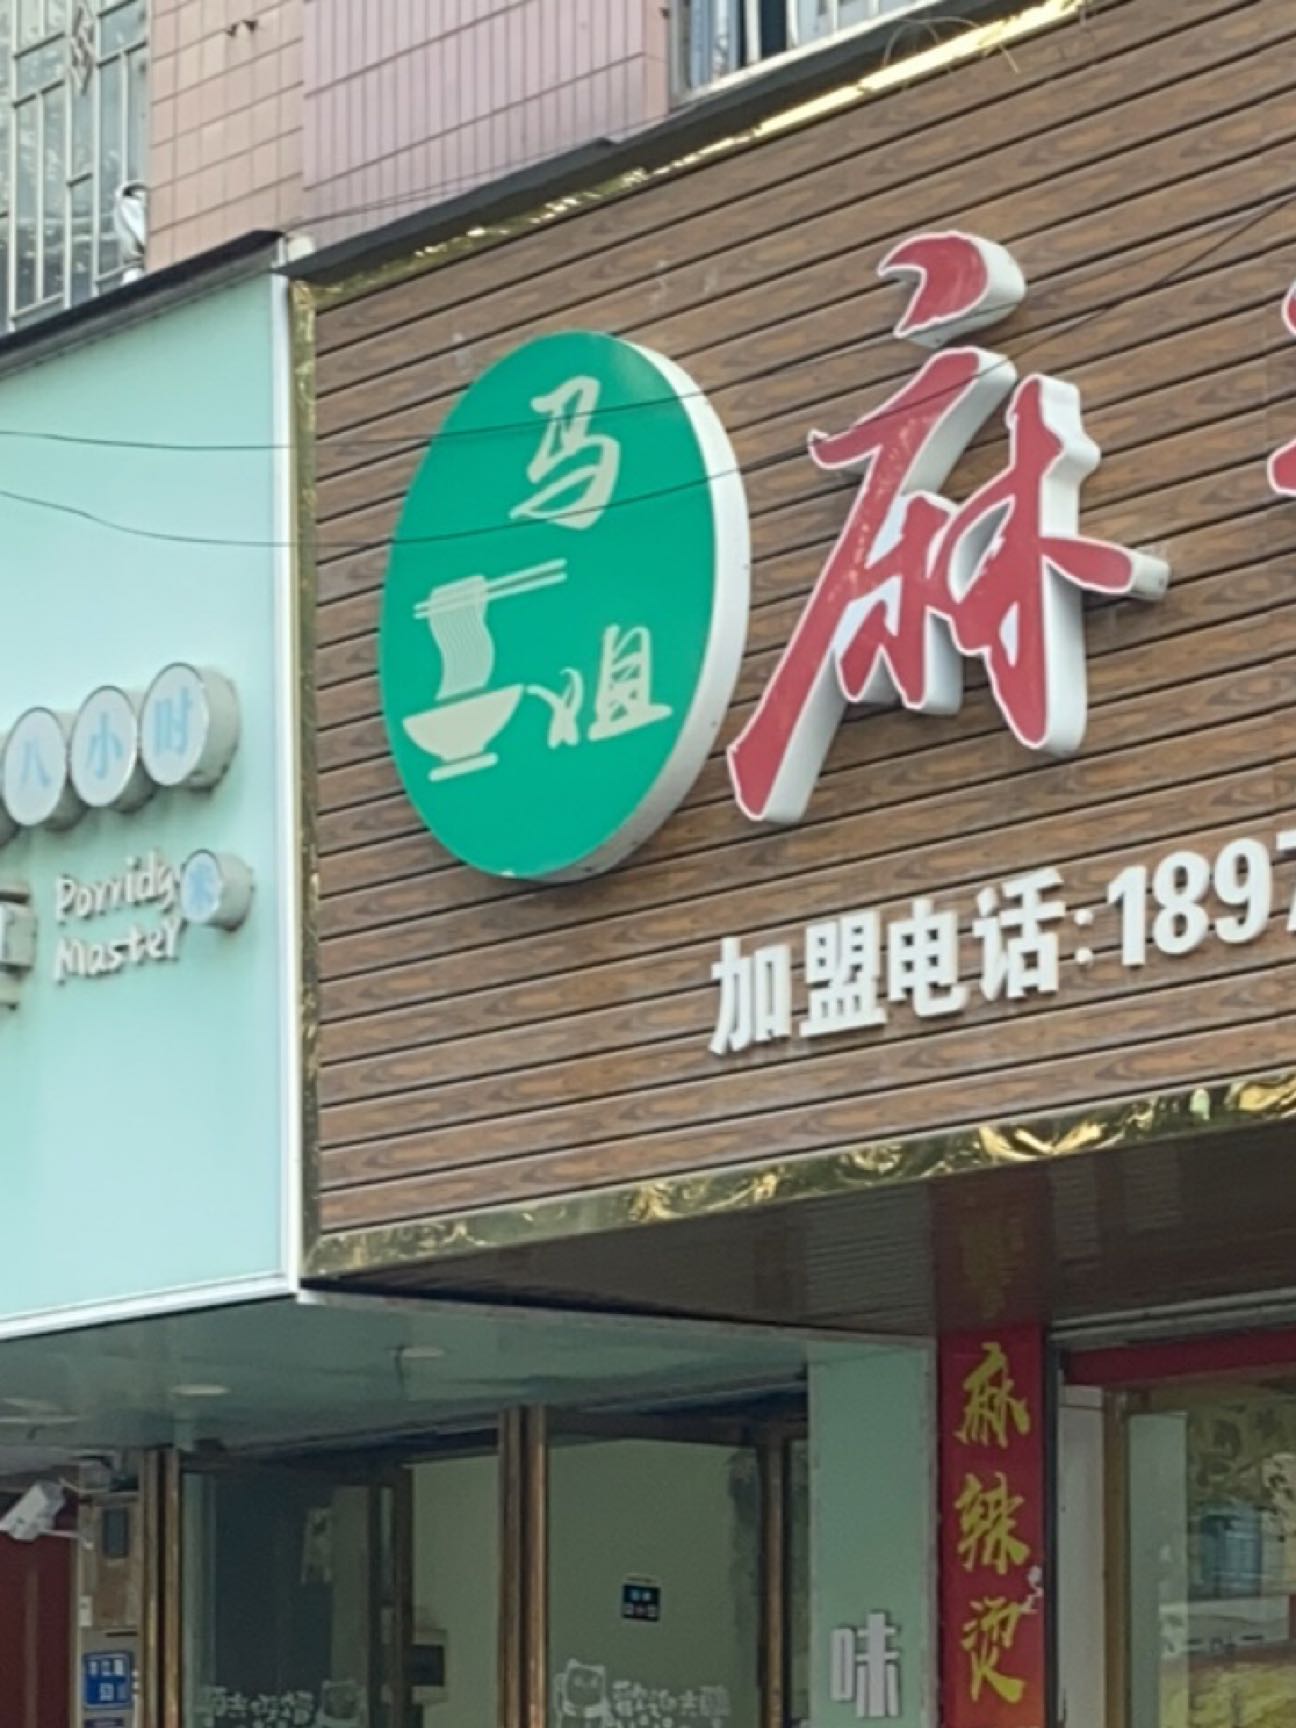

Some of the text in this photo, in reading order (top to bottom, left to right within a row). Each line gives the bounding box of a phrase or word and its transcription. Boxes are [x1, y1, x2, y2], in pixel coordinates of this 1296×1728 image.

[55, 848, 182, 926] Porridg
[953, 1341, 1031, 1703] 麻辣烫
